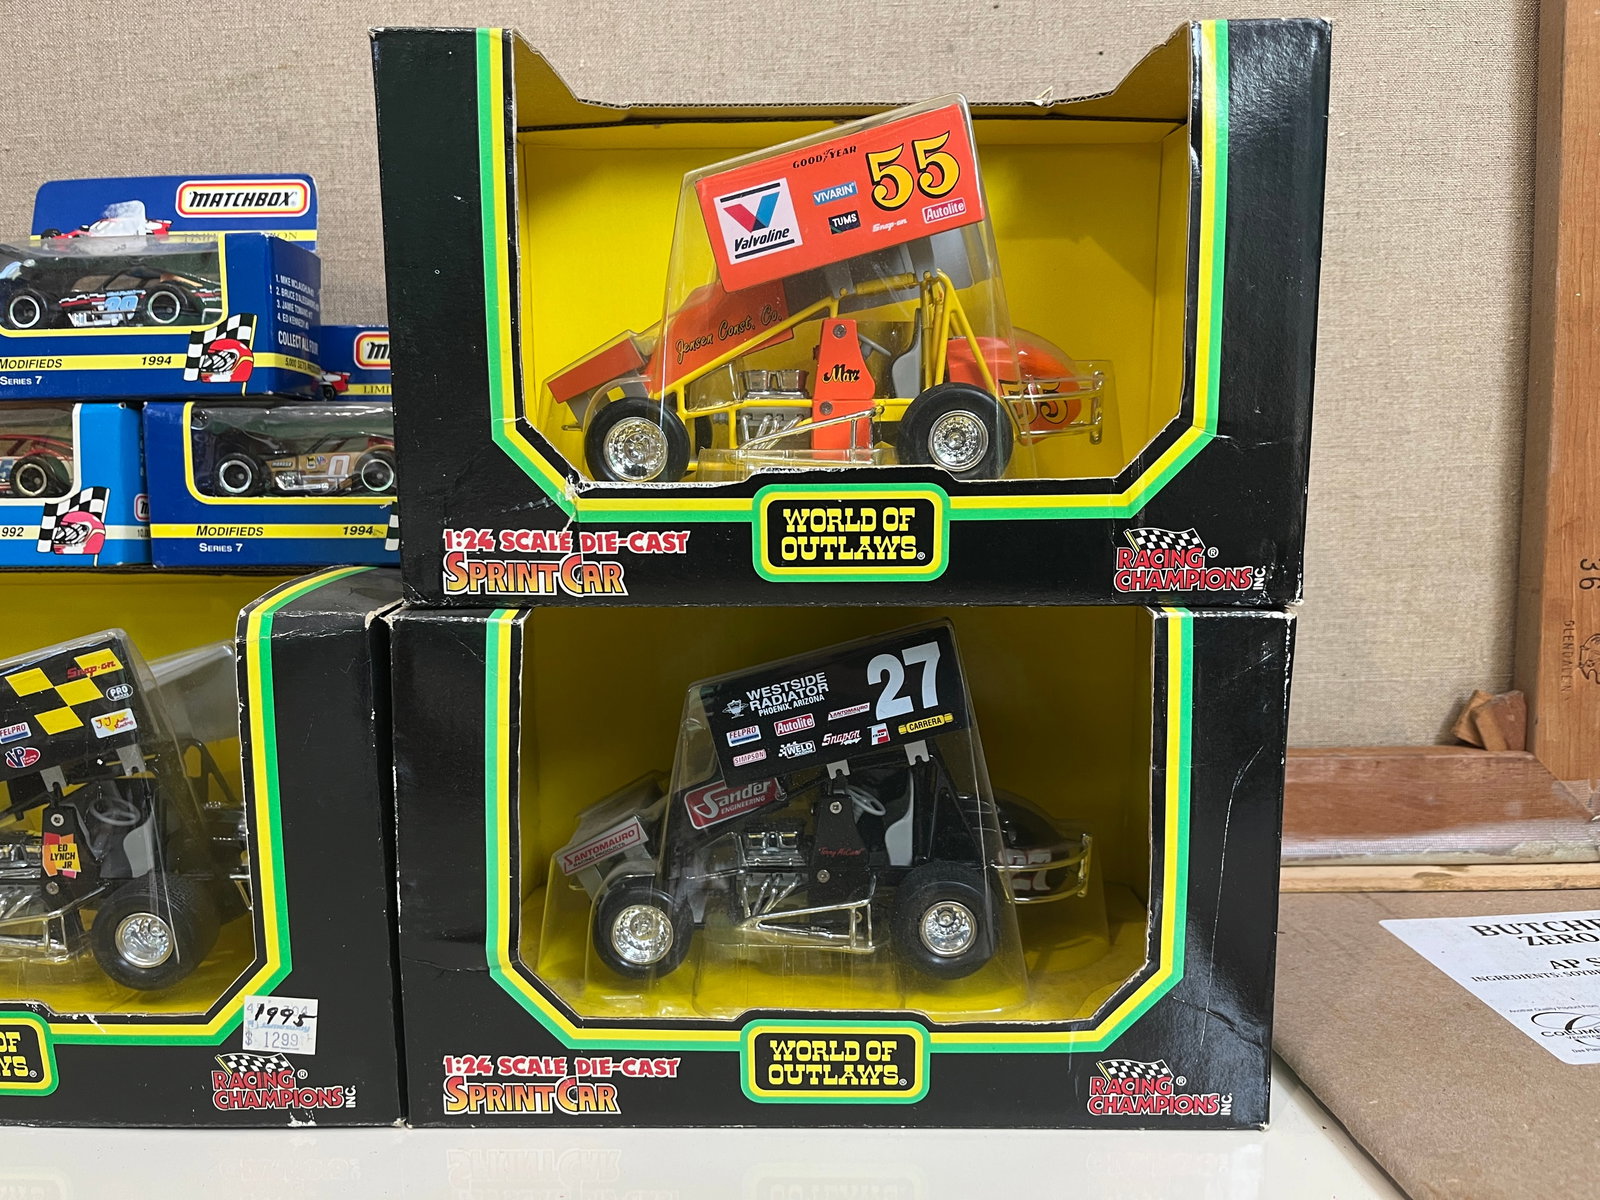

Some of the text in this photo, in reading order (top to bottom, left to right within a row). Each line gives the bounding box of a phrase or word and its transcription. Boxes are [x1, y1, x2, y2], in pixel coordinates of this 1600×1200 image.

[865, 130, 960, 211] 55
[189, 191, 296, 207] MATCHBOX
[813, 184, 853, 203] VIVARIN
[832, 213, 858, 227] TUMS
[926, 201, 965, 221] Autolite
[734, 227, 790, 252] Valvoline
[278, 330, 301, 349] COLLECT
[676, 304, 782, 364] Jensen Const. Co.
[141, 355, 172, 366] 1994
[35, 375, 42, 385] 7
[822, 364, 860, 384] Max
[783, 506, 915, 533] WORLD OF
[343, 525, 374, 535] 1994
[236, 543, 243, 553] 7
[443, 528, 690, 554] 1:24 SCALE DIE-CAST
[781, 535, 917, 561] OUTLAWS
[1117, 547, 1206, 570] RACING
[1114, 565, 1254, 592] CHAMPIONS
[746, 672, 827, 701] WESTSIDE
[867, 641, 941, 721] 27
[110, 685, 128, 697] PRO
[749, 682, 829, 711] RADIATOR
[793, 694, 825, 709] ARIZONA
[0, 724, 26, 736] FELPRO
[729, 727, 757, 739] FELPRO
[777, 717, 813, 734] Autolite
[909, 716, 942, 731] CARRERA
[6, 747, 26, 767] VP
[735, 751, 764, 763] SIMPSON
[786, 742, 813, 756] WELD
[694, 781, 771, 819] Sander
[721, 795, 766, 814] ENGINEERING
[50, 852, 76, 861] LYNCH
[57, 843, 68, 852] ED
[62, 861, 72, 869] JR
[1517, 933, 1600, 946] ZERO
[1549, 959, 1581, 969] AP
[1470, 972, 1563, 982] INGREDIENTS:
[255, 1003, 318, 1027] 1995
[245, 1030, 253, 1047] $
[770, 1040, 898, 1062] WORLD OF
[443, 1054, 682, 1078] 1:24 SCALE DIE-CAST
[768, 1064, 899, 1086] OUTLAWS
[211, 1069, 296, 1091] RACING
[1090, 1076, 1174, 1097] RACING
[213, 1086, 345, 1111] CHAMPIONS
[1087, 1093, 1220, 1116] CHAMPIONS
